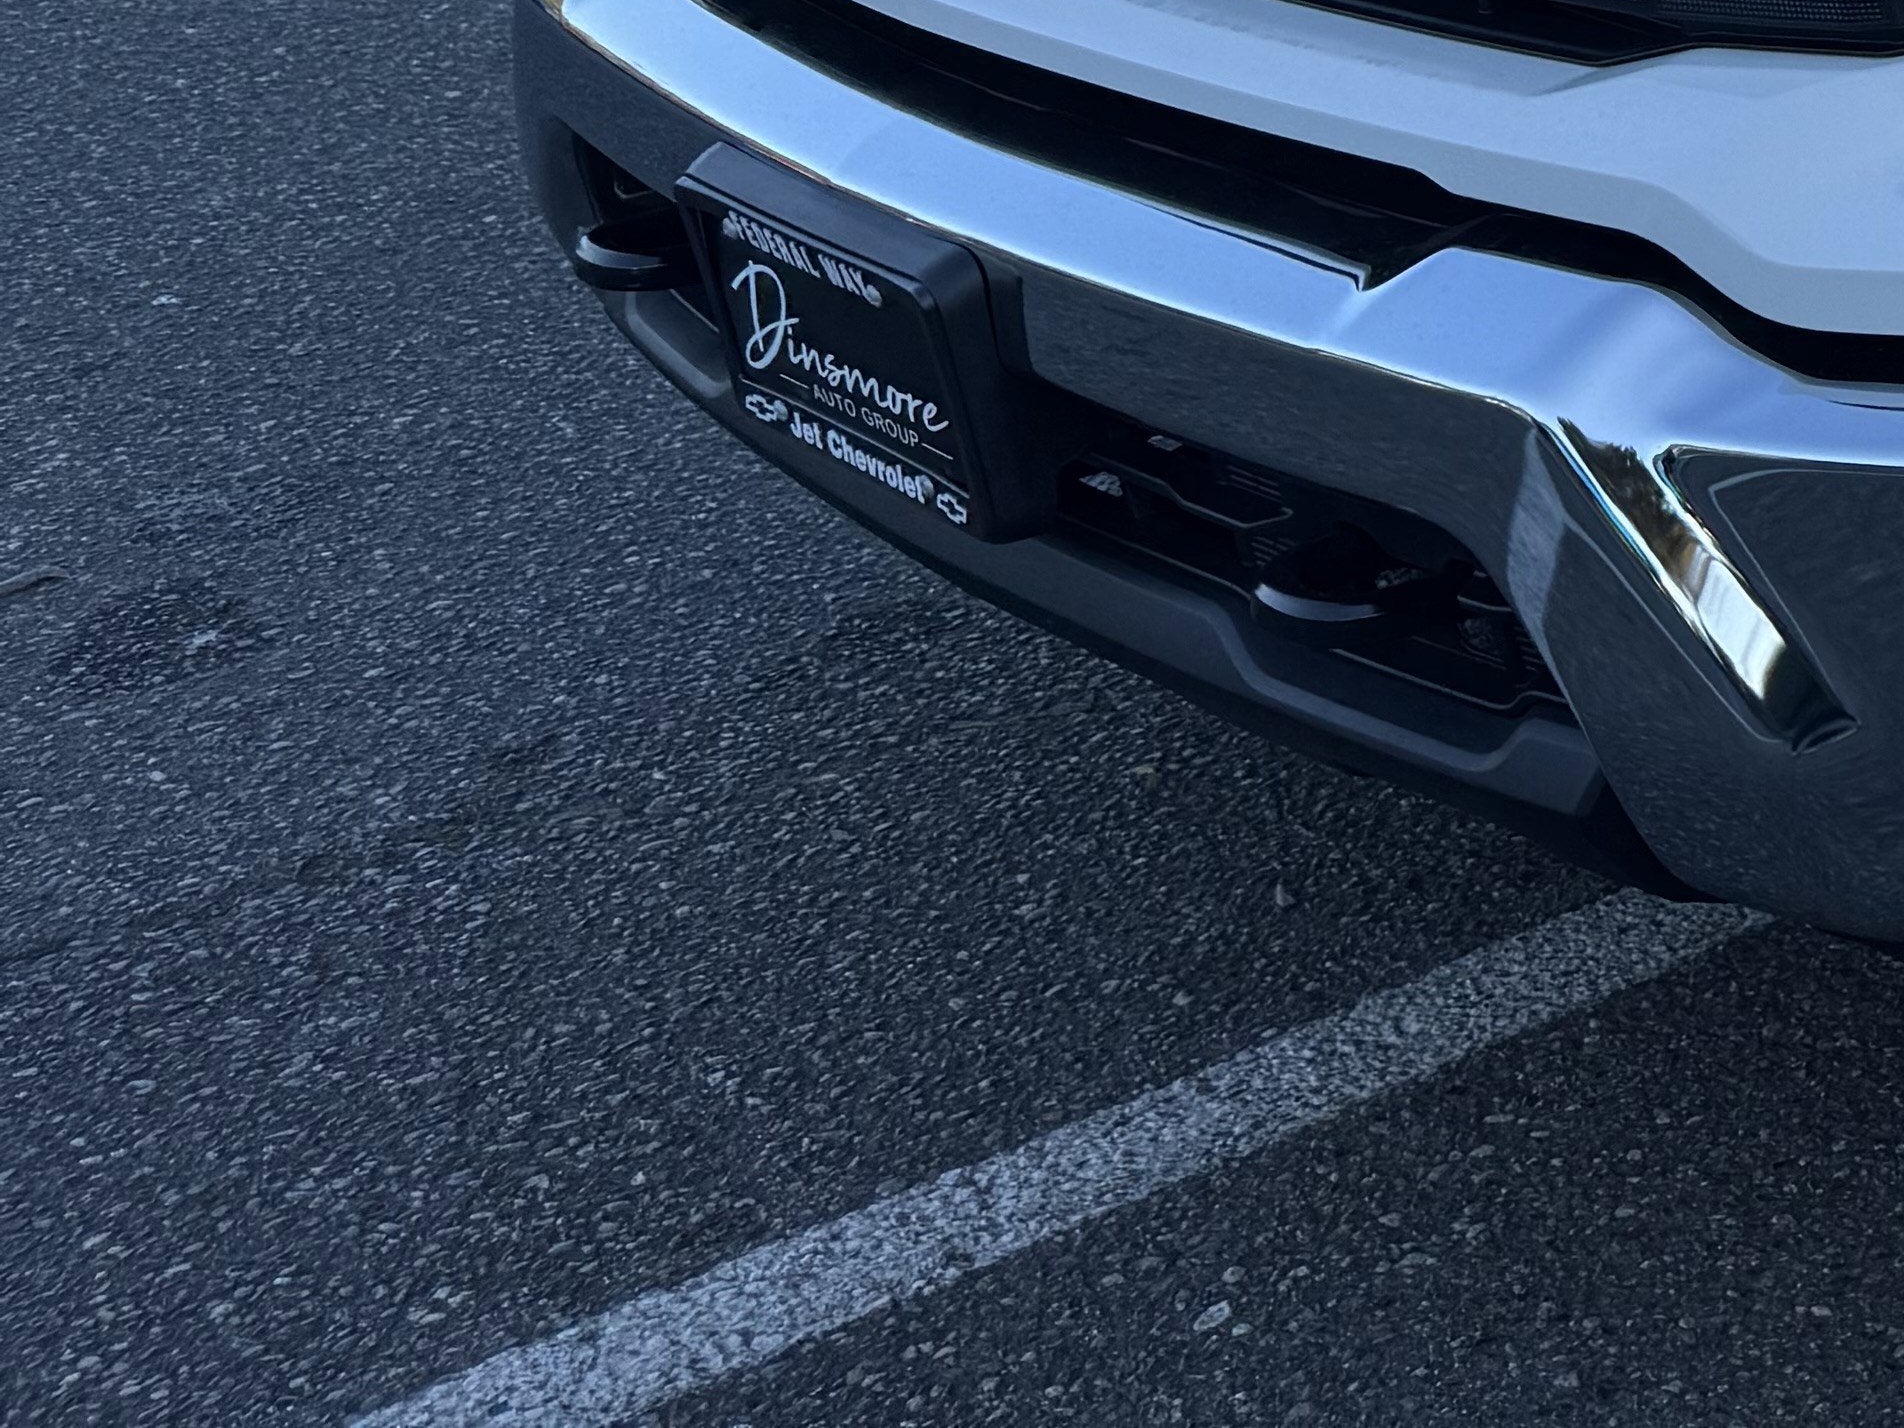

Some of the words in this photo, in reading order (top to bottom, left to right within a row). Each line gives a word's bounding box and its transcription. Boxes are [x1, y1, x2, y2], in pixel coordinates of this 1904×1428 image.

[728, 211, 822, 280] FEDERAL
[821, 252, 872, 304] WAY
[730, 259, 950, 433] Dinsmore
[790, 410, 824, 452] Jet
[827, 428, 928, 505] Chevrolet
[813, 382, 857, 419] AUTO
[861, 406, 919, 447] GROUP
